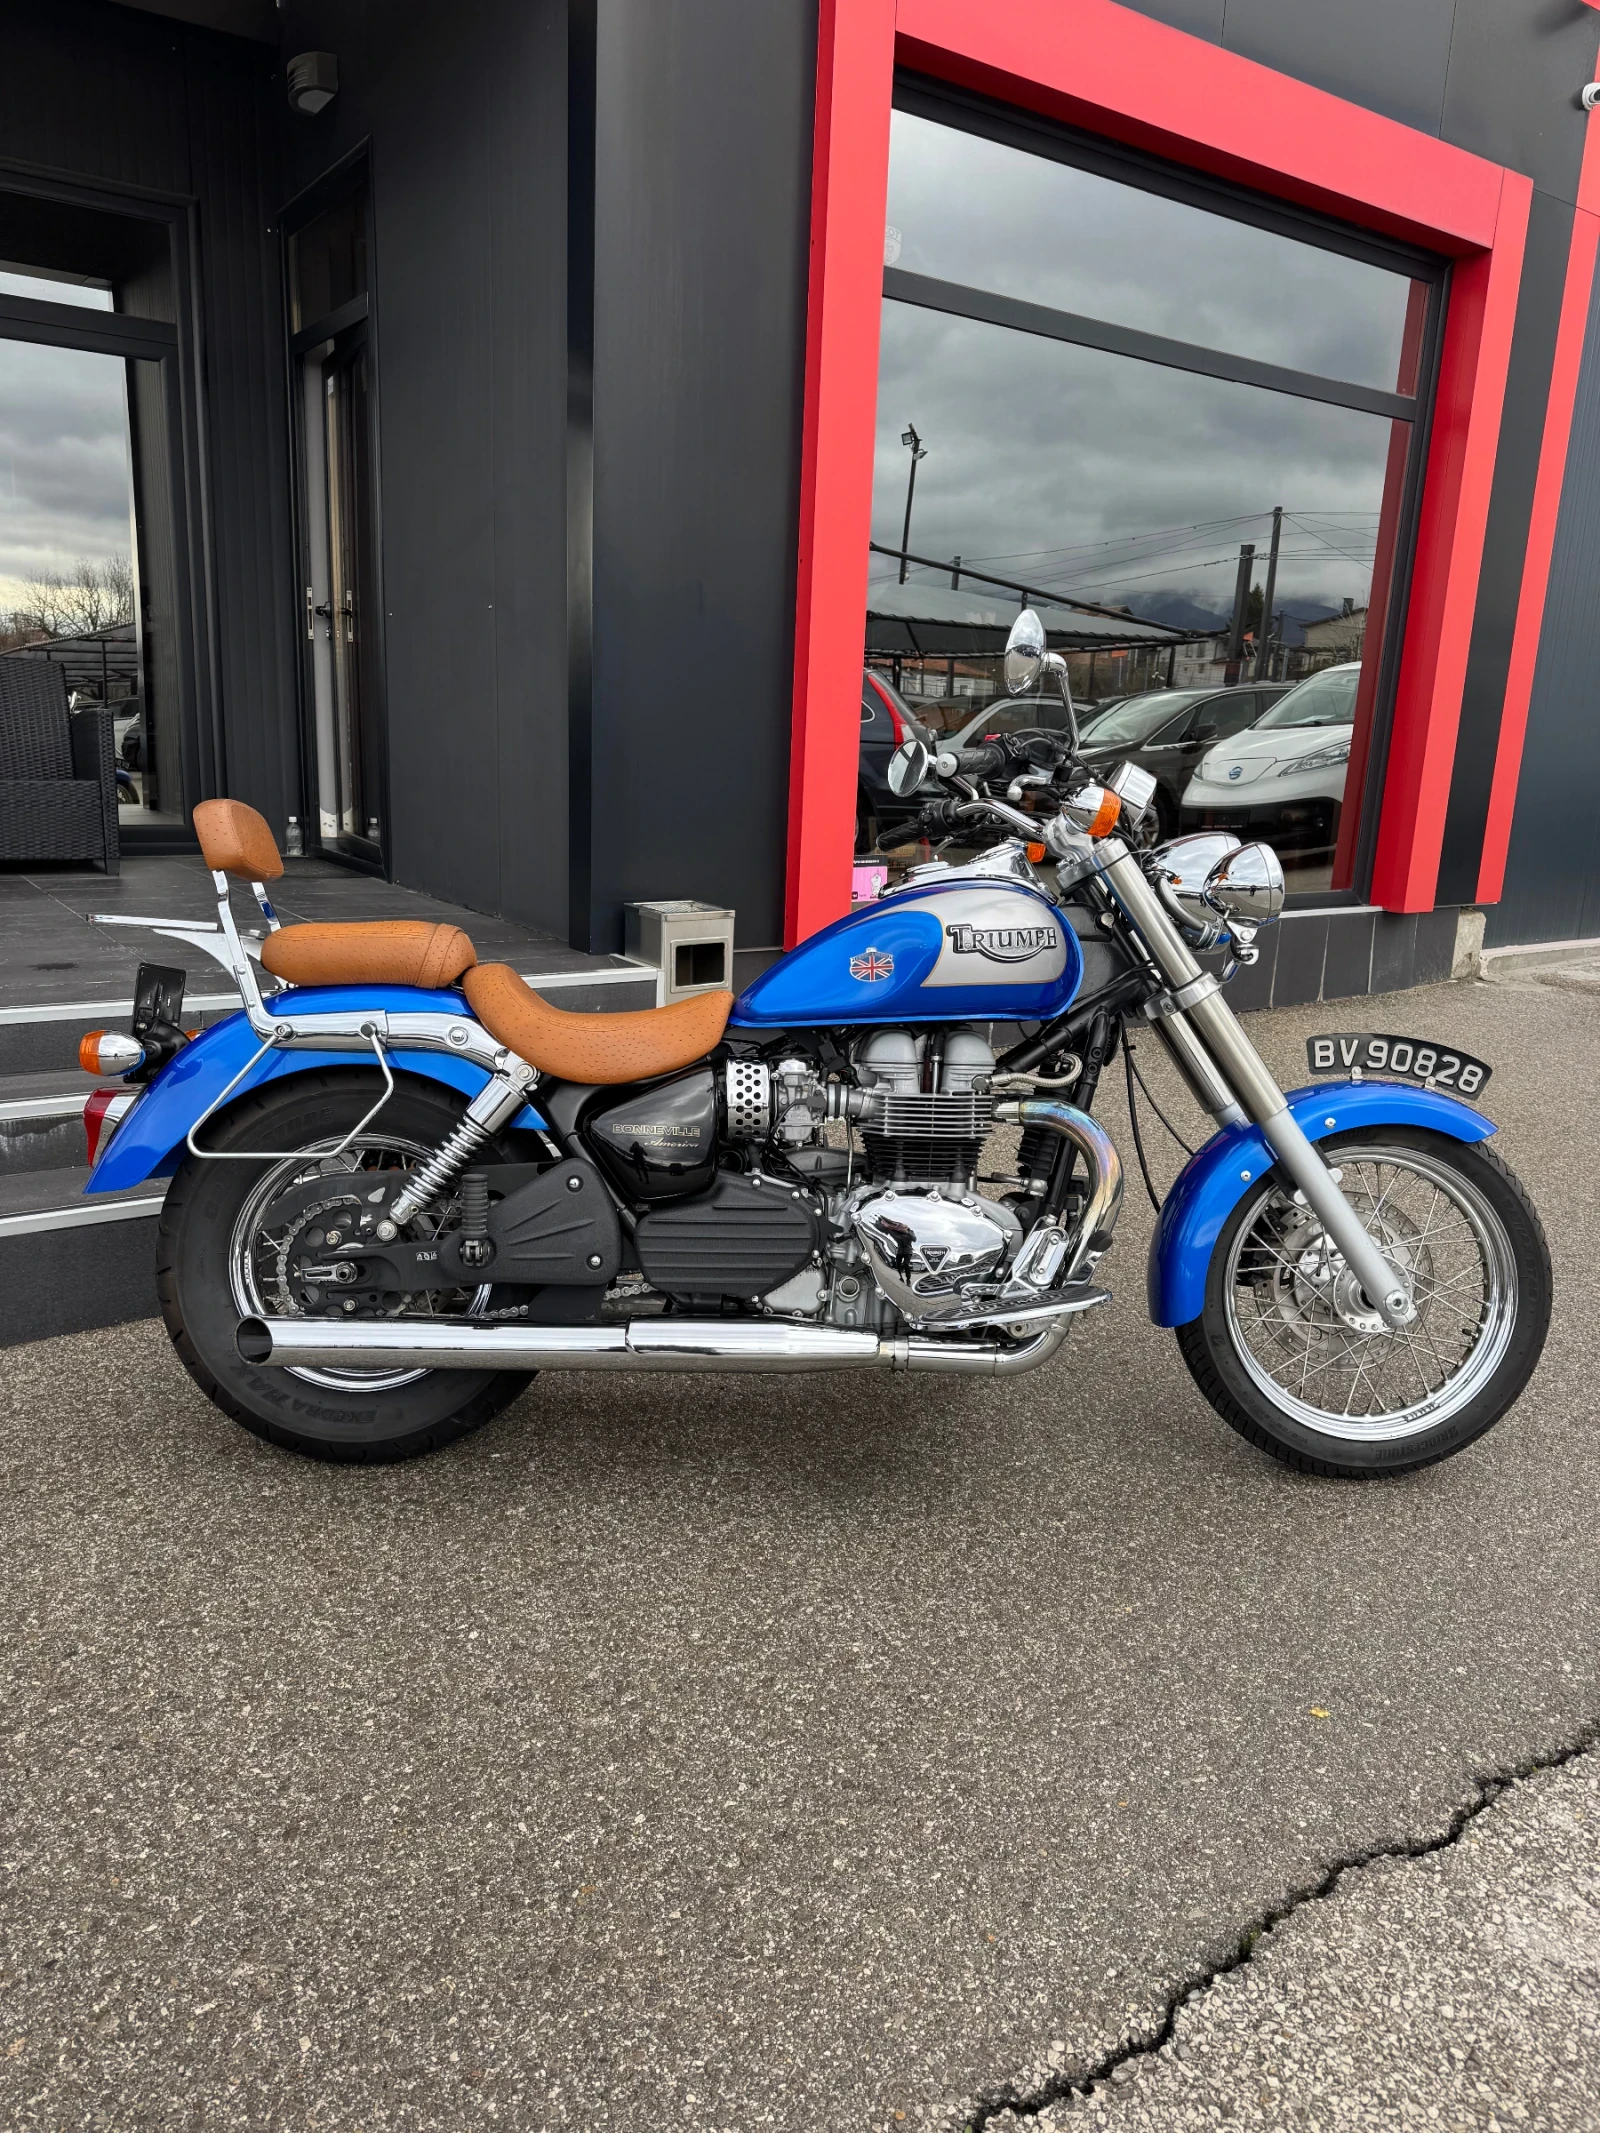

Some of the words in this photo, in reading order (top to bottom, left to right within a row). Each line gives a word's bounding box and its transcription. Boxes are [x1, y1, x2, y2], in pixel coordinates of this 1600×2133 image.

[948, 924, 1057, 953] TRIUMPH
[1313, 1038, 1359, 1068] BV
[1366, 1039, 1484, 1094] 90828
[612, 1123, 700, 1138] BONNEVILLE
